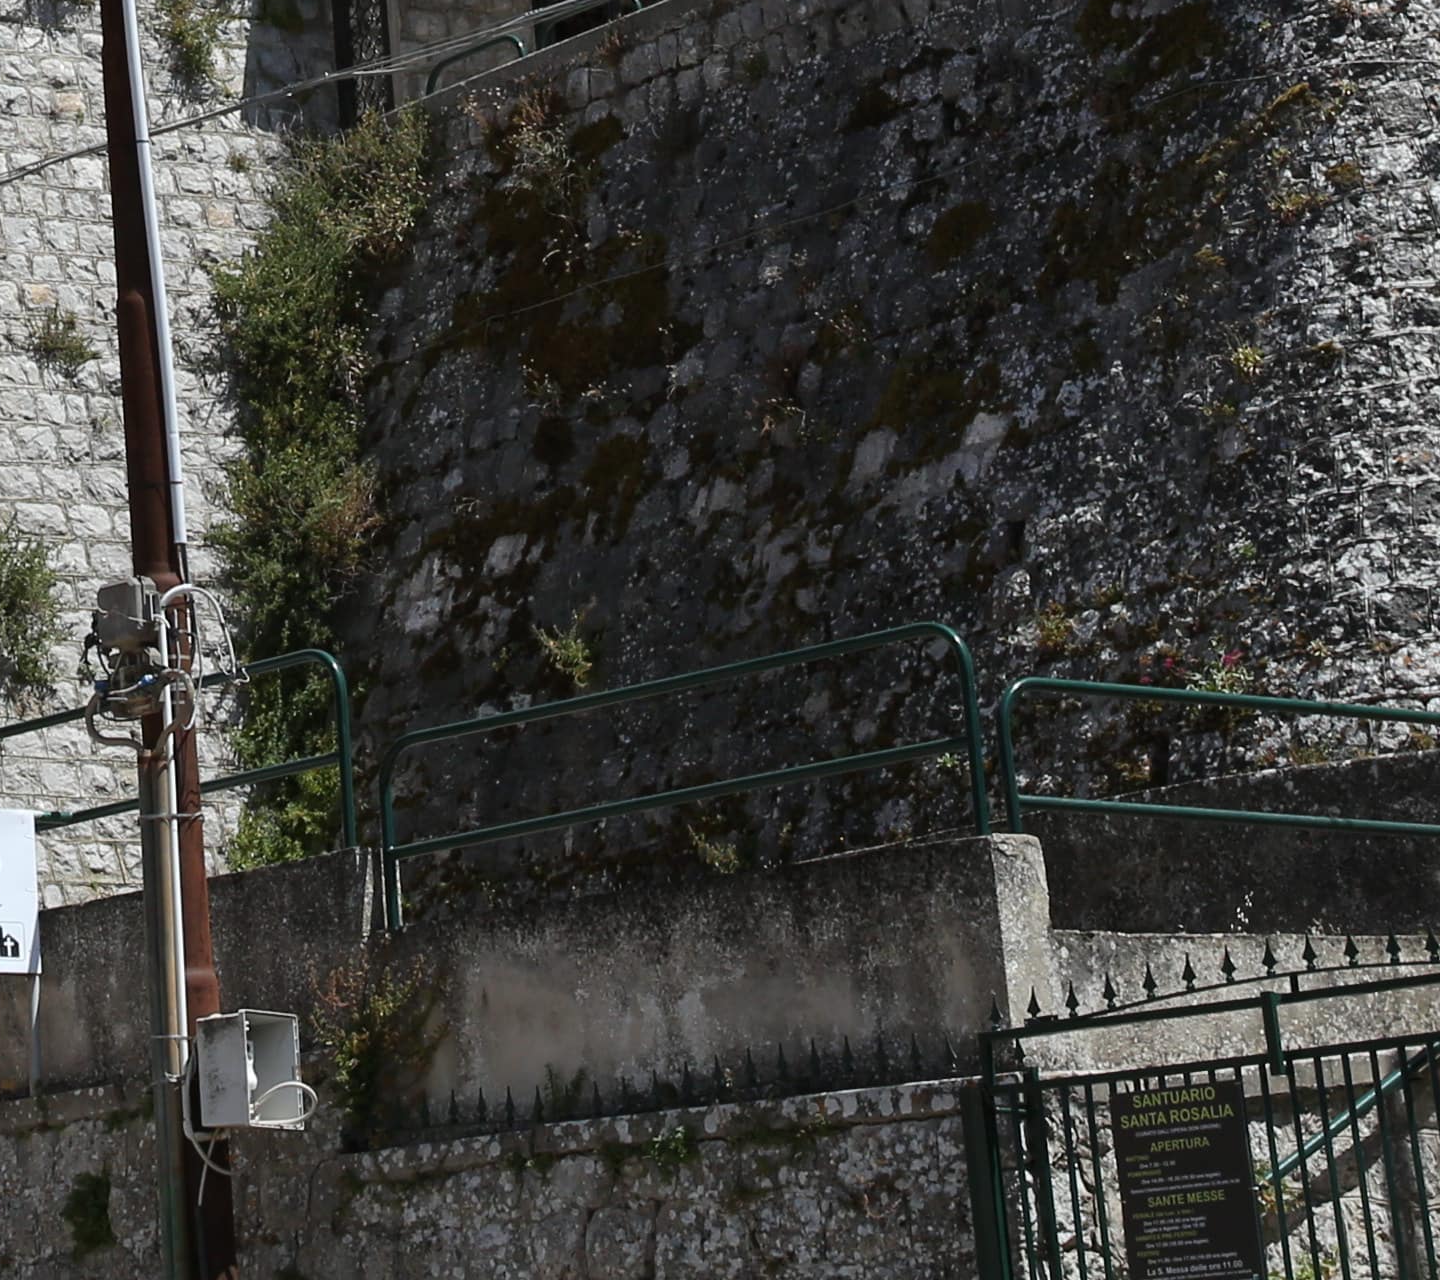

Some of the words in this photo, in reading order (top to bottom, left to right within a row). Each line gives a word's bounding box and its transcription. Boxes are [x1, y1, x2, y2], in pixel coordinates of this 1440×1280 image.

[1132, 1086, 1216, 1109] SANTUARIO
[1120, 1111, 1167, 1129] SANTA
[1169, 1103, 1235, 1123] ROSALIA
[1150, 1136, 1211, 1153] APERTURA
[1147, 1193, 1185, 1208] SANTE
[1187, 1189, 1225, 1204] MESSE
